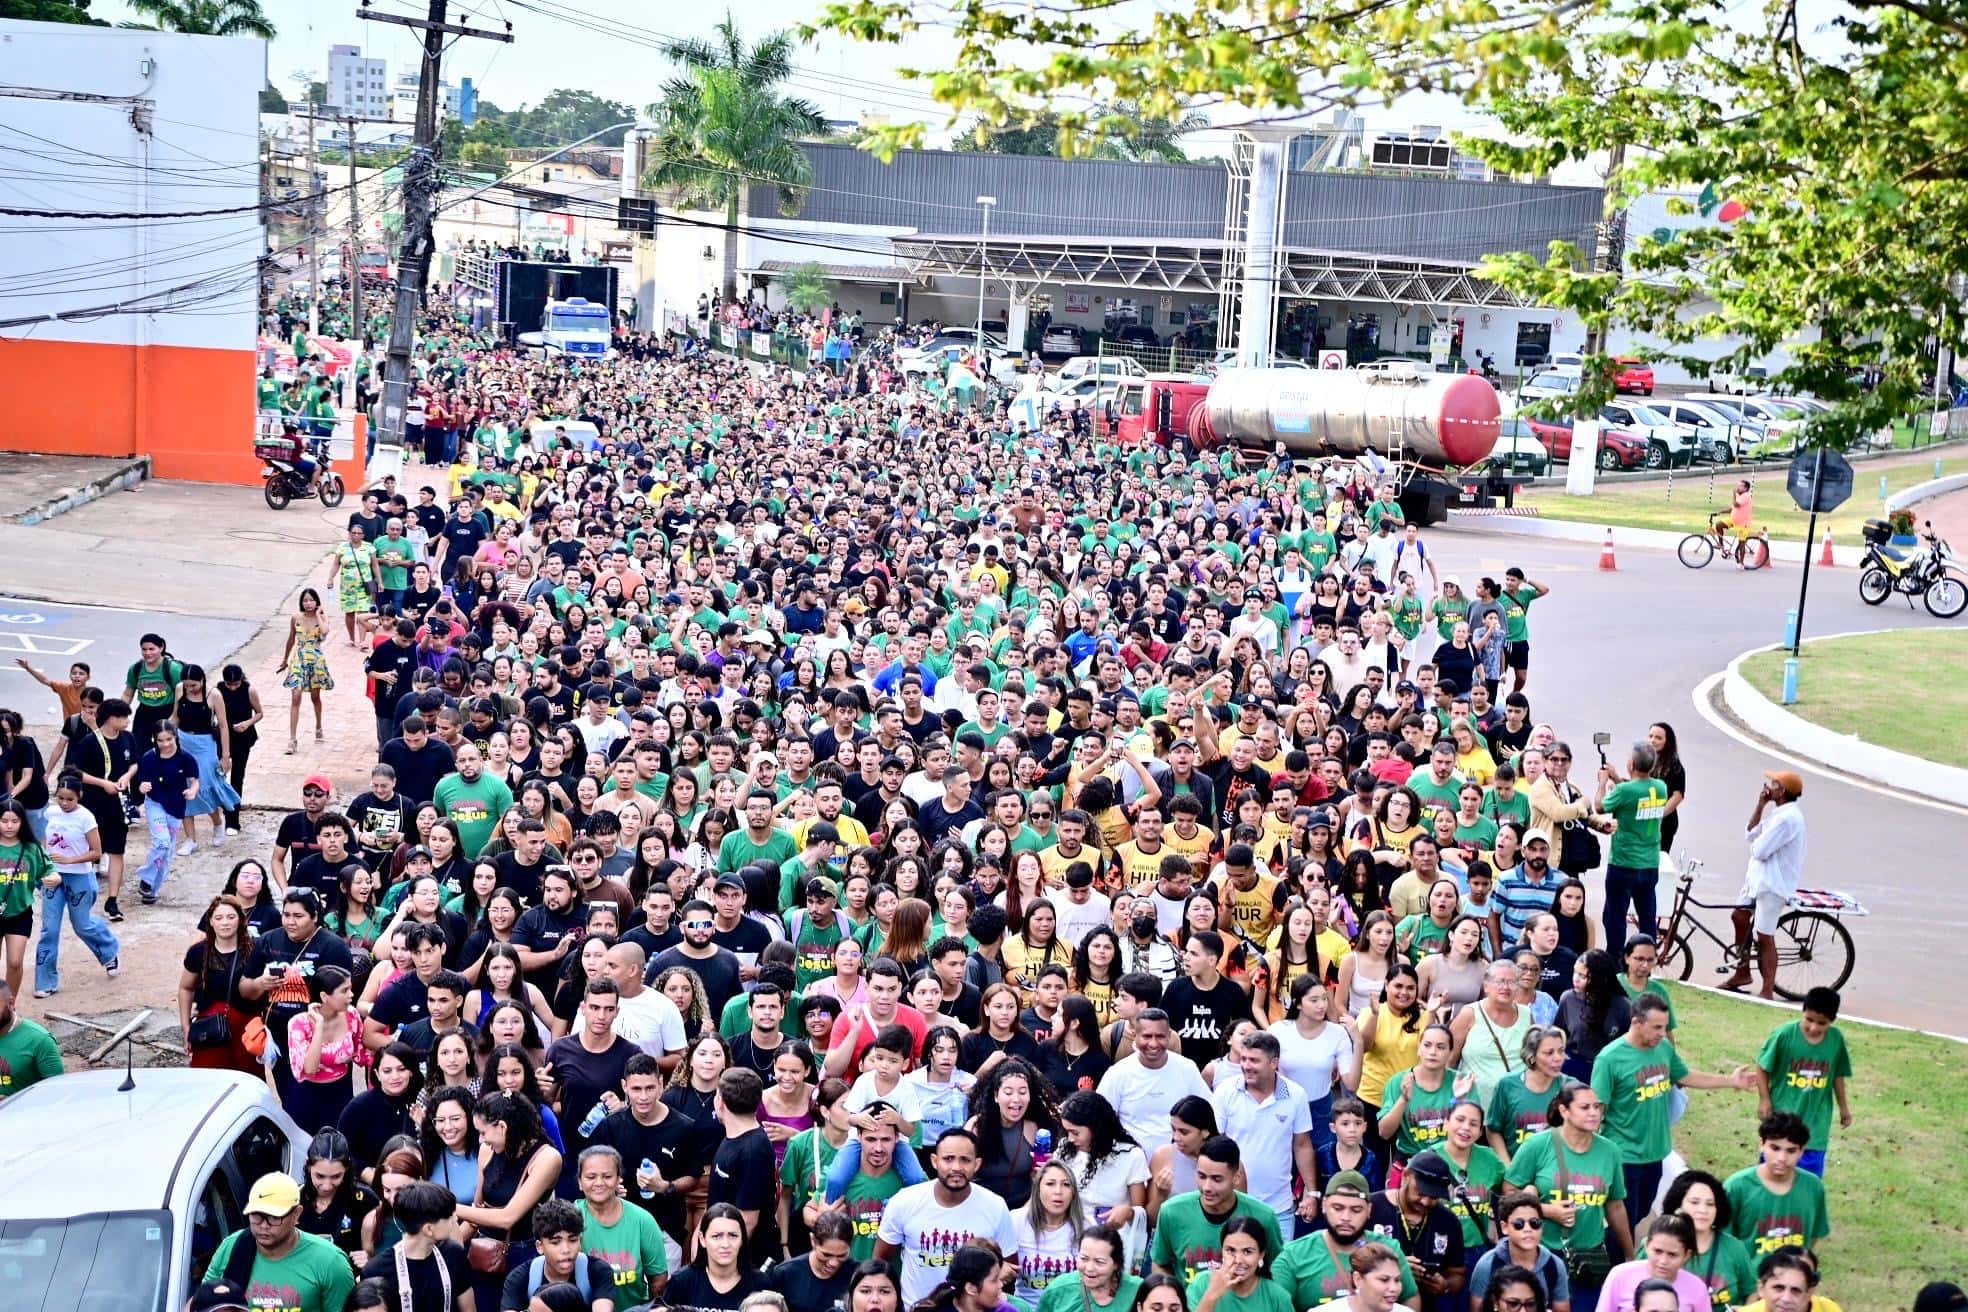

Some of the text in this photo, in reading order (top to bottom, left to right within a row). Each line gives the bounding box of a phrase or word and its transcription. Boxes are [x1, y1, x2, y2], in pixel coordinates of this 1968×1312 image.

[450, 811, 489, 822] Jesus
[0, 872, 29, 882] esus
[1409, 1126, 1448, 1142] Jesu
[851, 1220, 880, 1236] Jes
[919, 1251, 955, 1268] Jes
